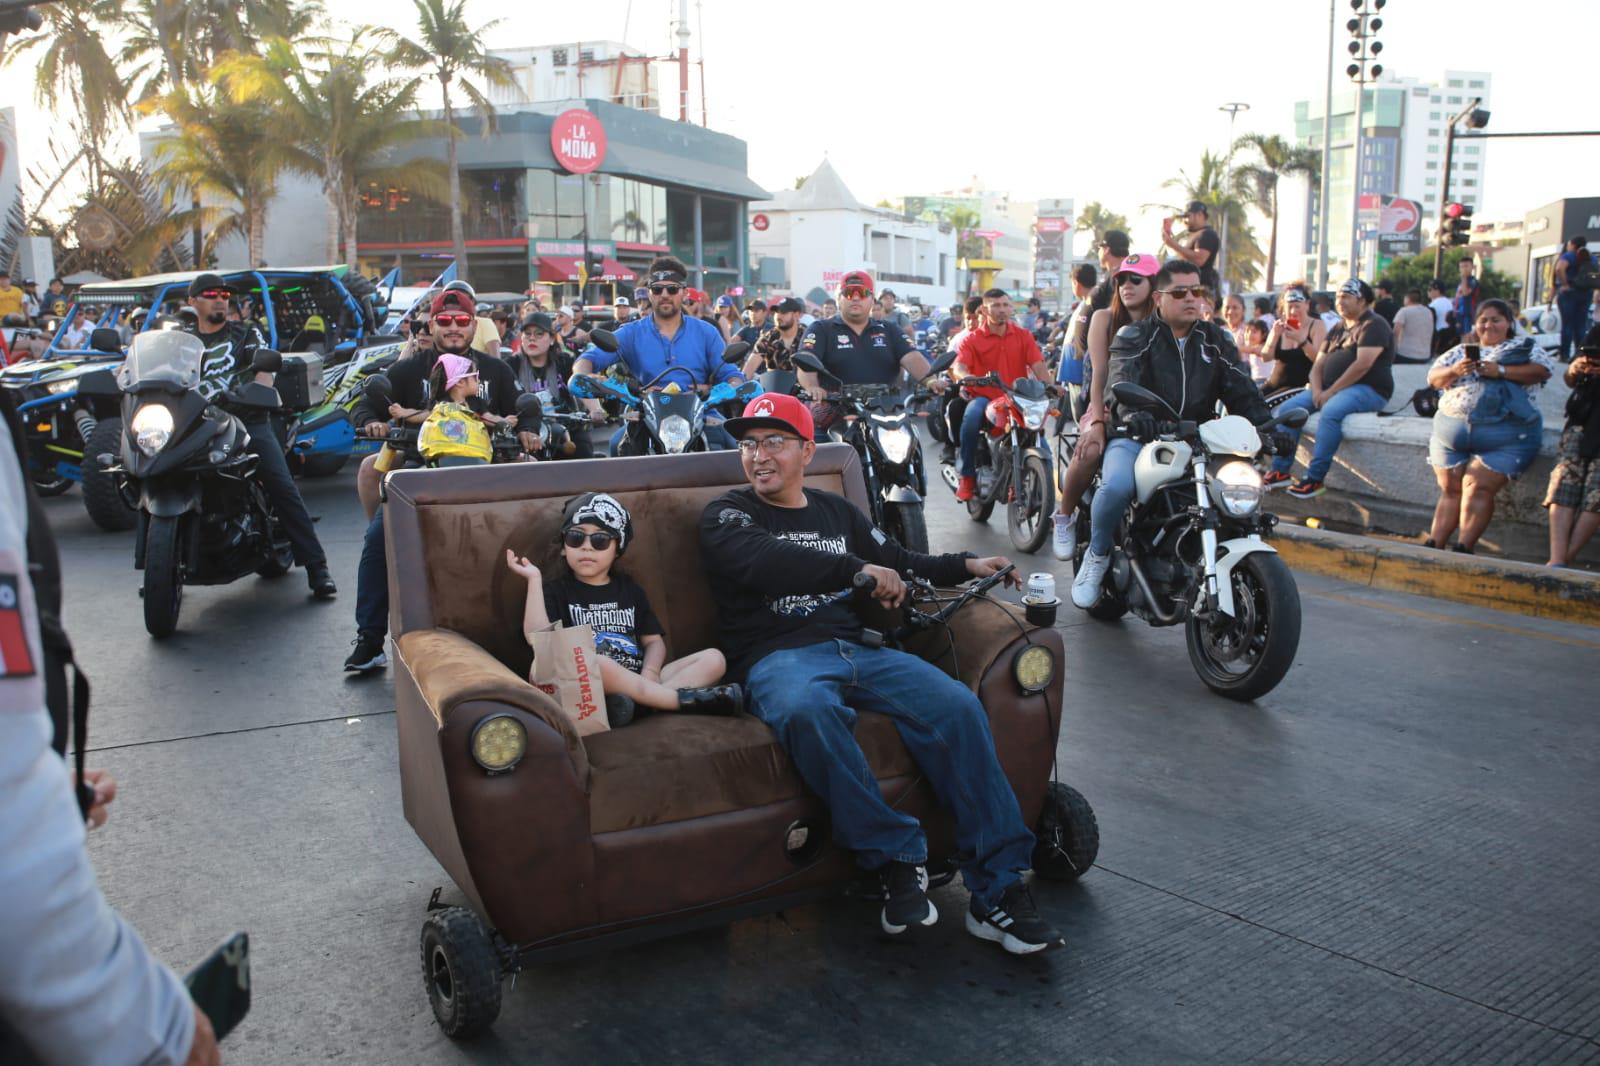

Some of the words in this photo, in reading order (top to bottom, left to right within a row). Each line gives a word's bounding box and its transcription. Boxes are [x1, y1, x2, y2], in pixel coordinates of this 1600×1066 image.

[572, 124, 586, 140] LA
[561, 138, 597, 160] MONA
[572, 646, 598, 721] VENADOS
